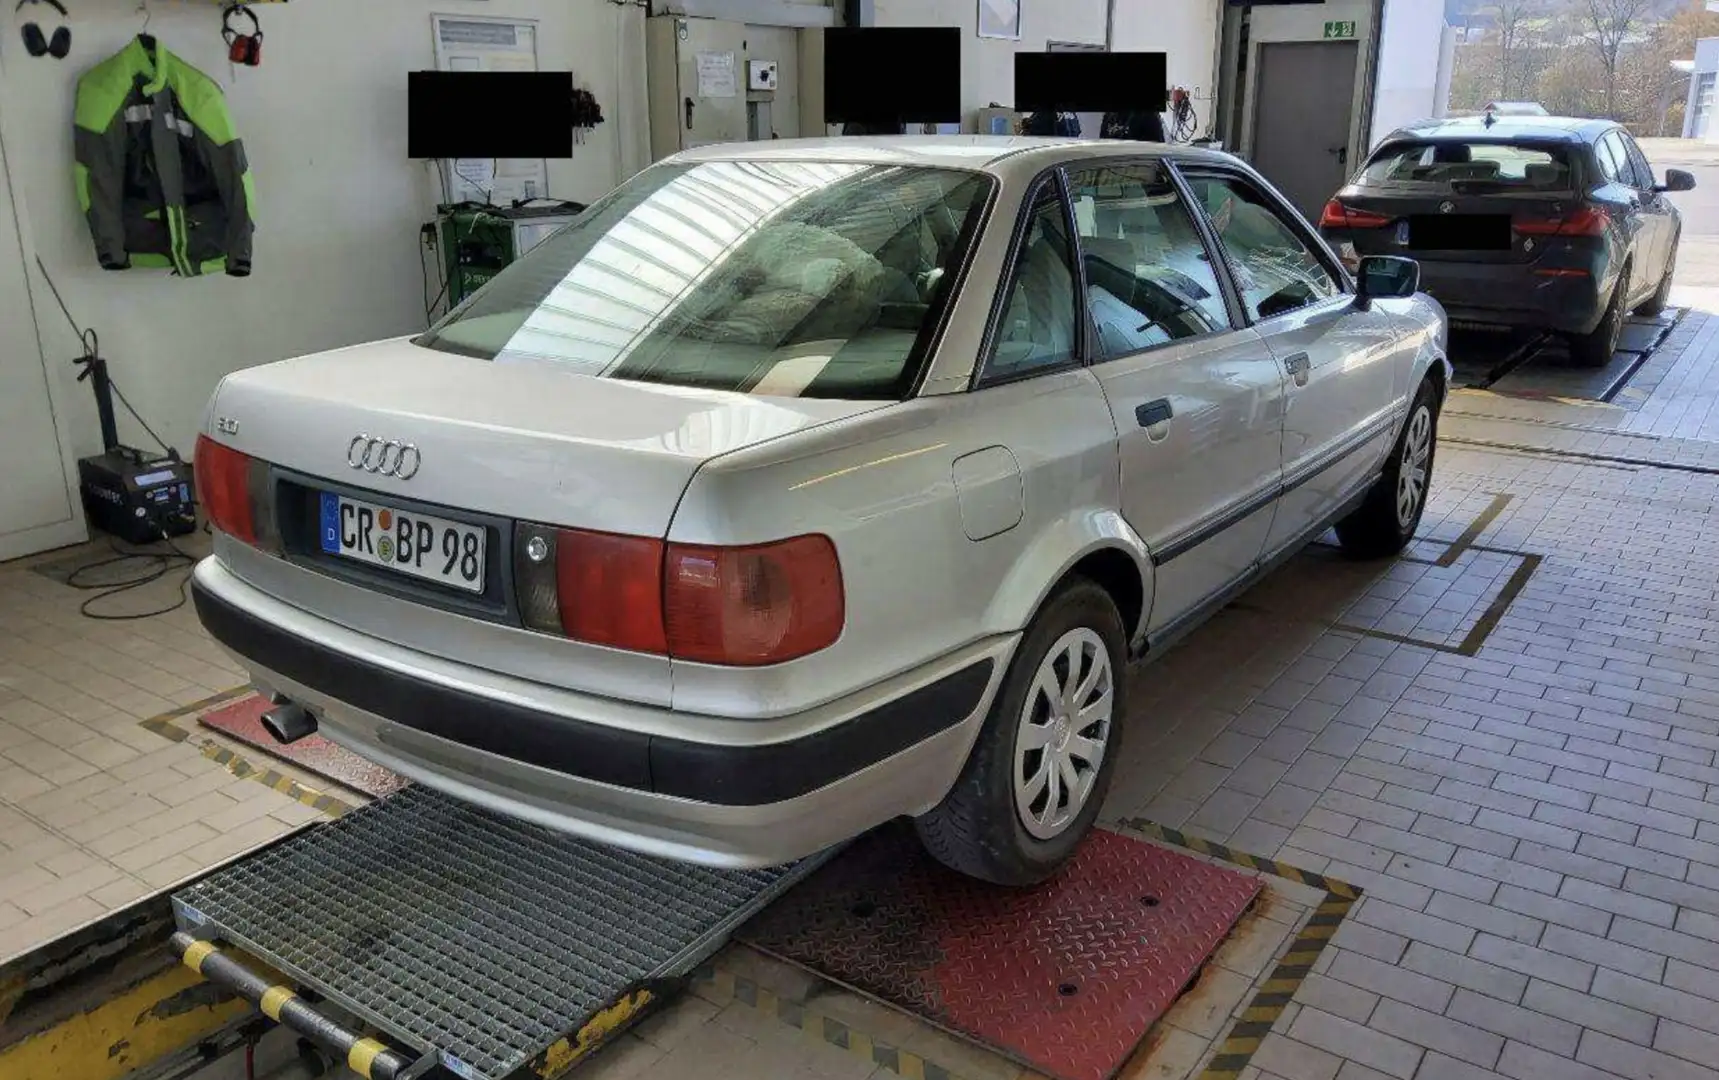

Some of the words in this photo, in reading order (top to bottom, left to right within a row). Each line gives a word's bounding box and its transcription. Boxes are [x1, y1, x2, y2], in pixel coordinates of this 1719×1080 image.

[327, 528, 335, 541] D
[340, 503, 373, 554] CR
[397, 517, 433, 567] BP
[442, 528, 478, 581] 98
